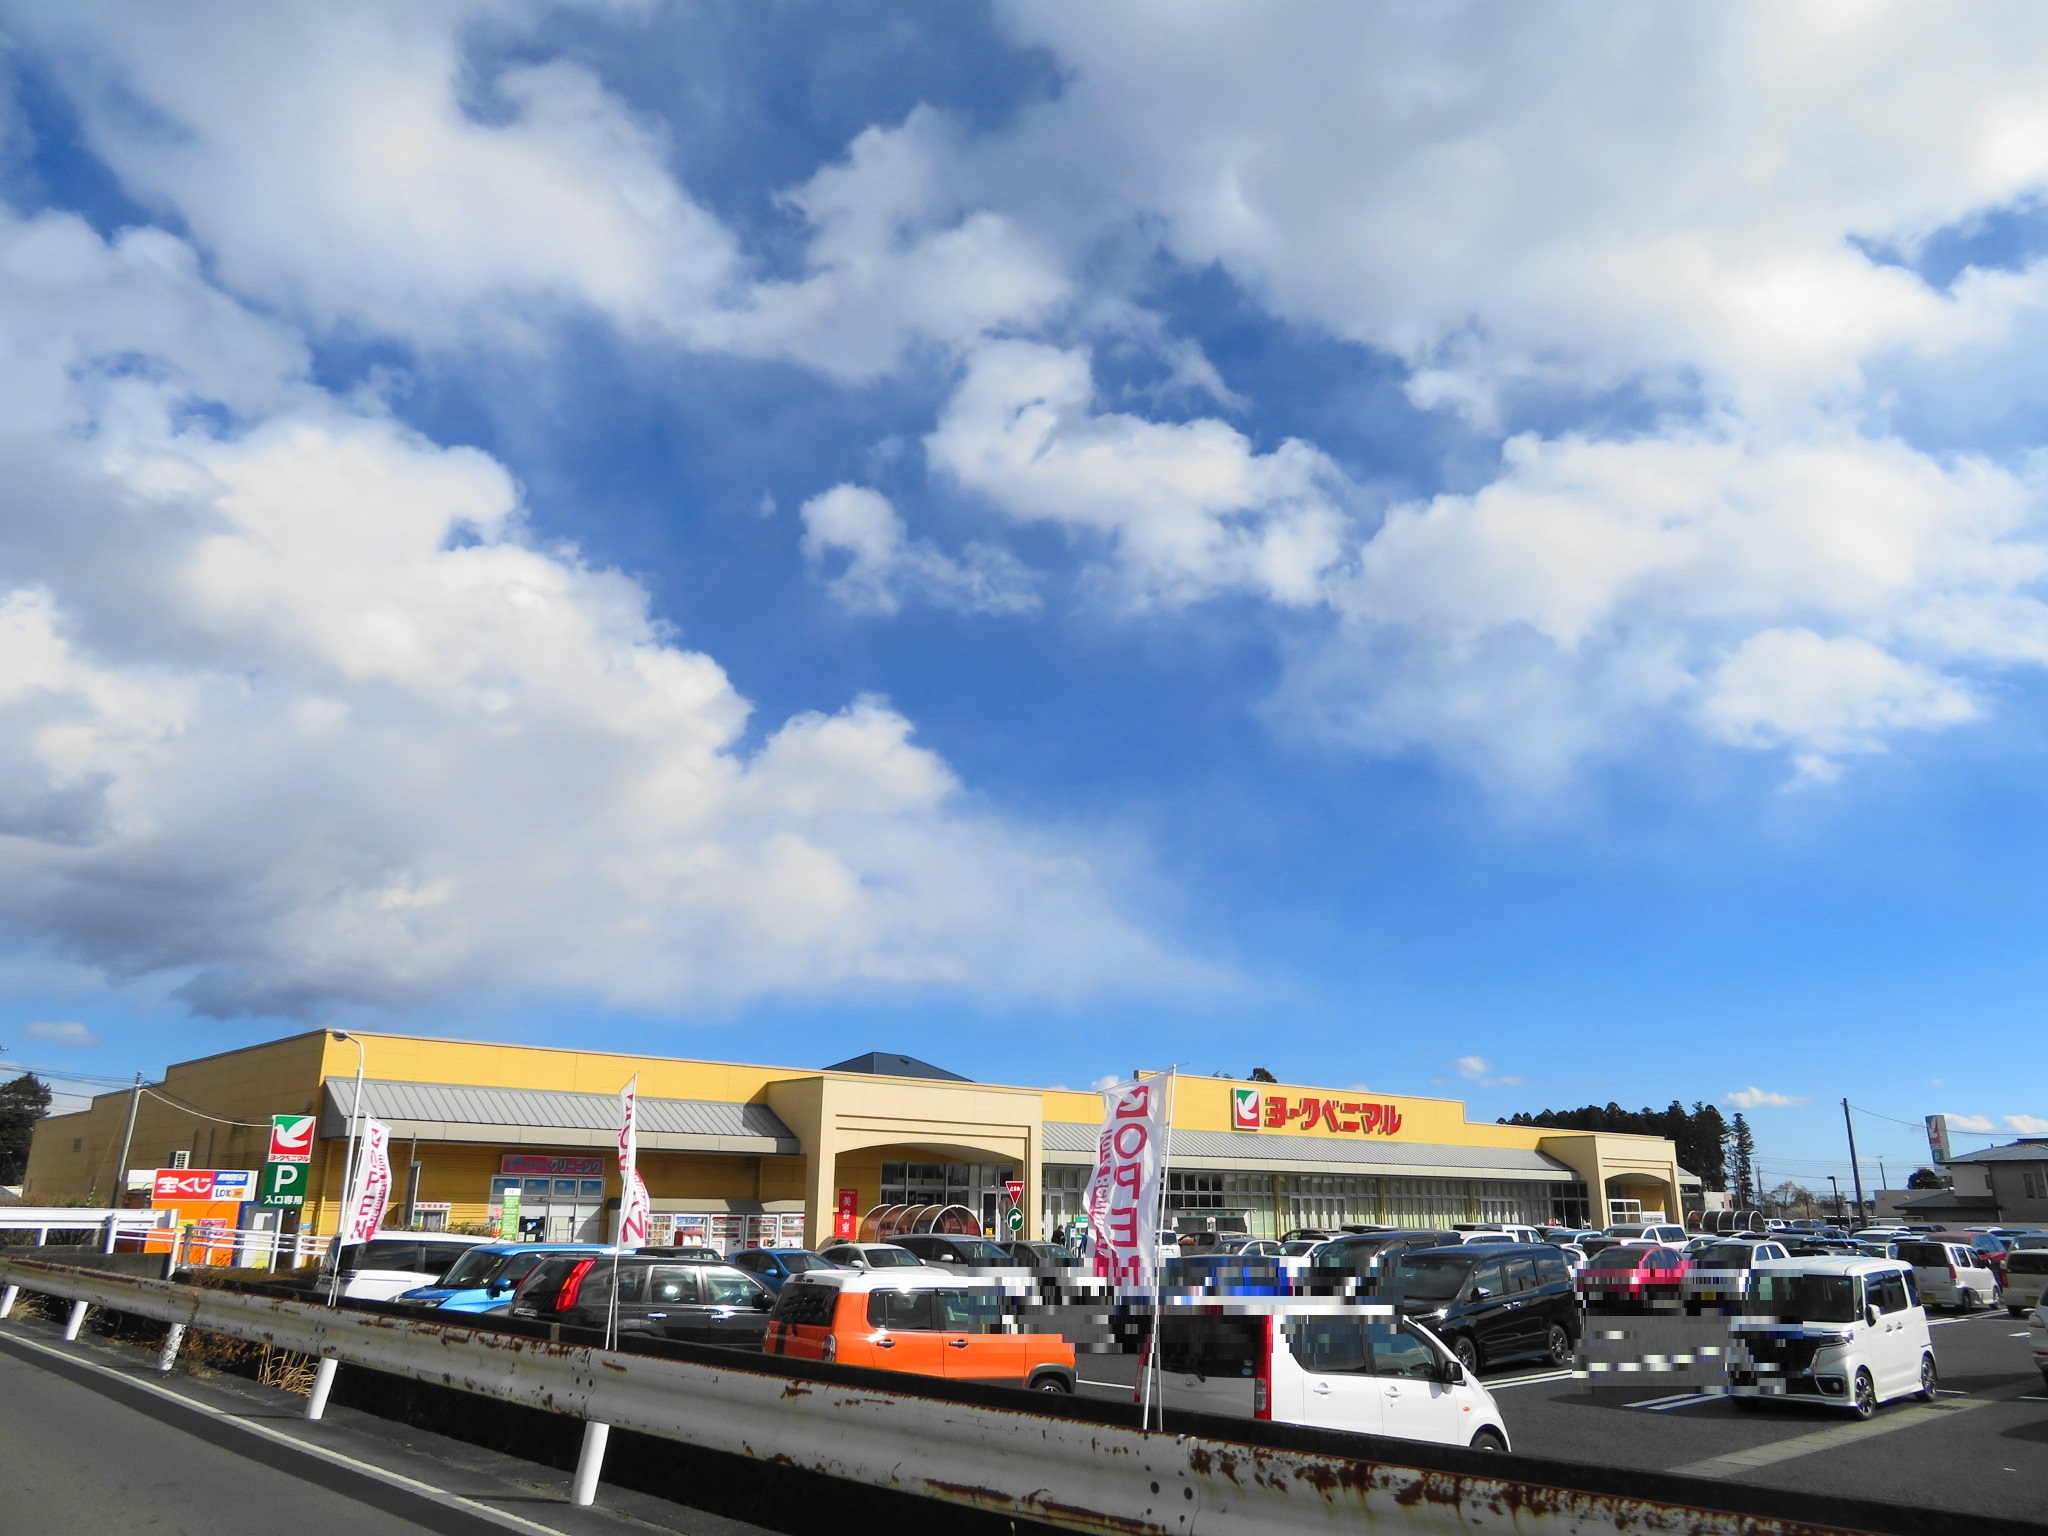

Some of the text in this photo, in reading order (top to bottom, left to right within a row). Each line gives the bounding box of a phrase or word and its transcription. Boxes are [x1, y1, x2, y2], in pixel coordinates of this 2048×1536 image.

[1266, 1096, 1402, 1135] ヨークベニマル
[157, 1176, 211, 1194] 宝くじ
[274, 1165, 298, 1193] P
[350, 1149, 380, 1240] OPEN
[264, 1195, 303, 1205] 入口専用
[841, 1196, 852, 1233] 美容室
